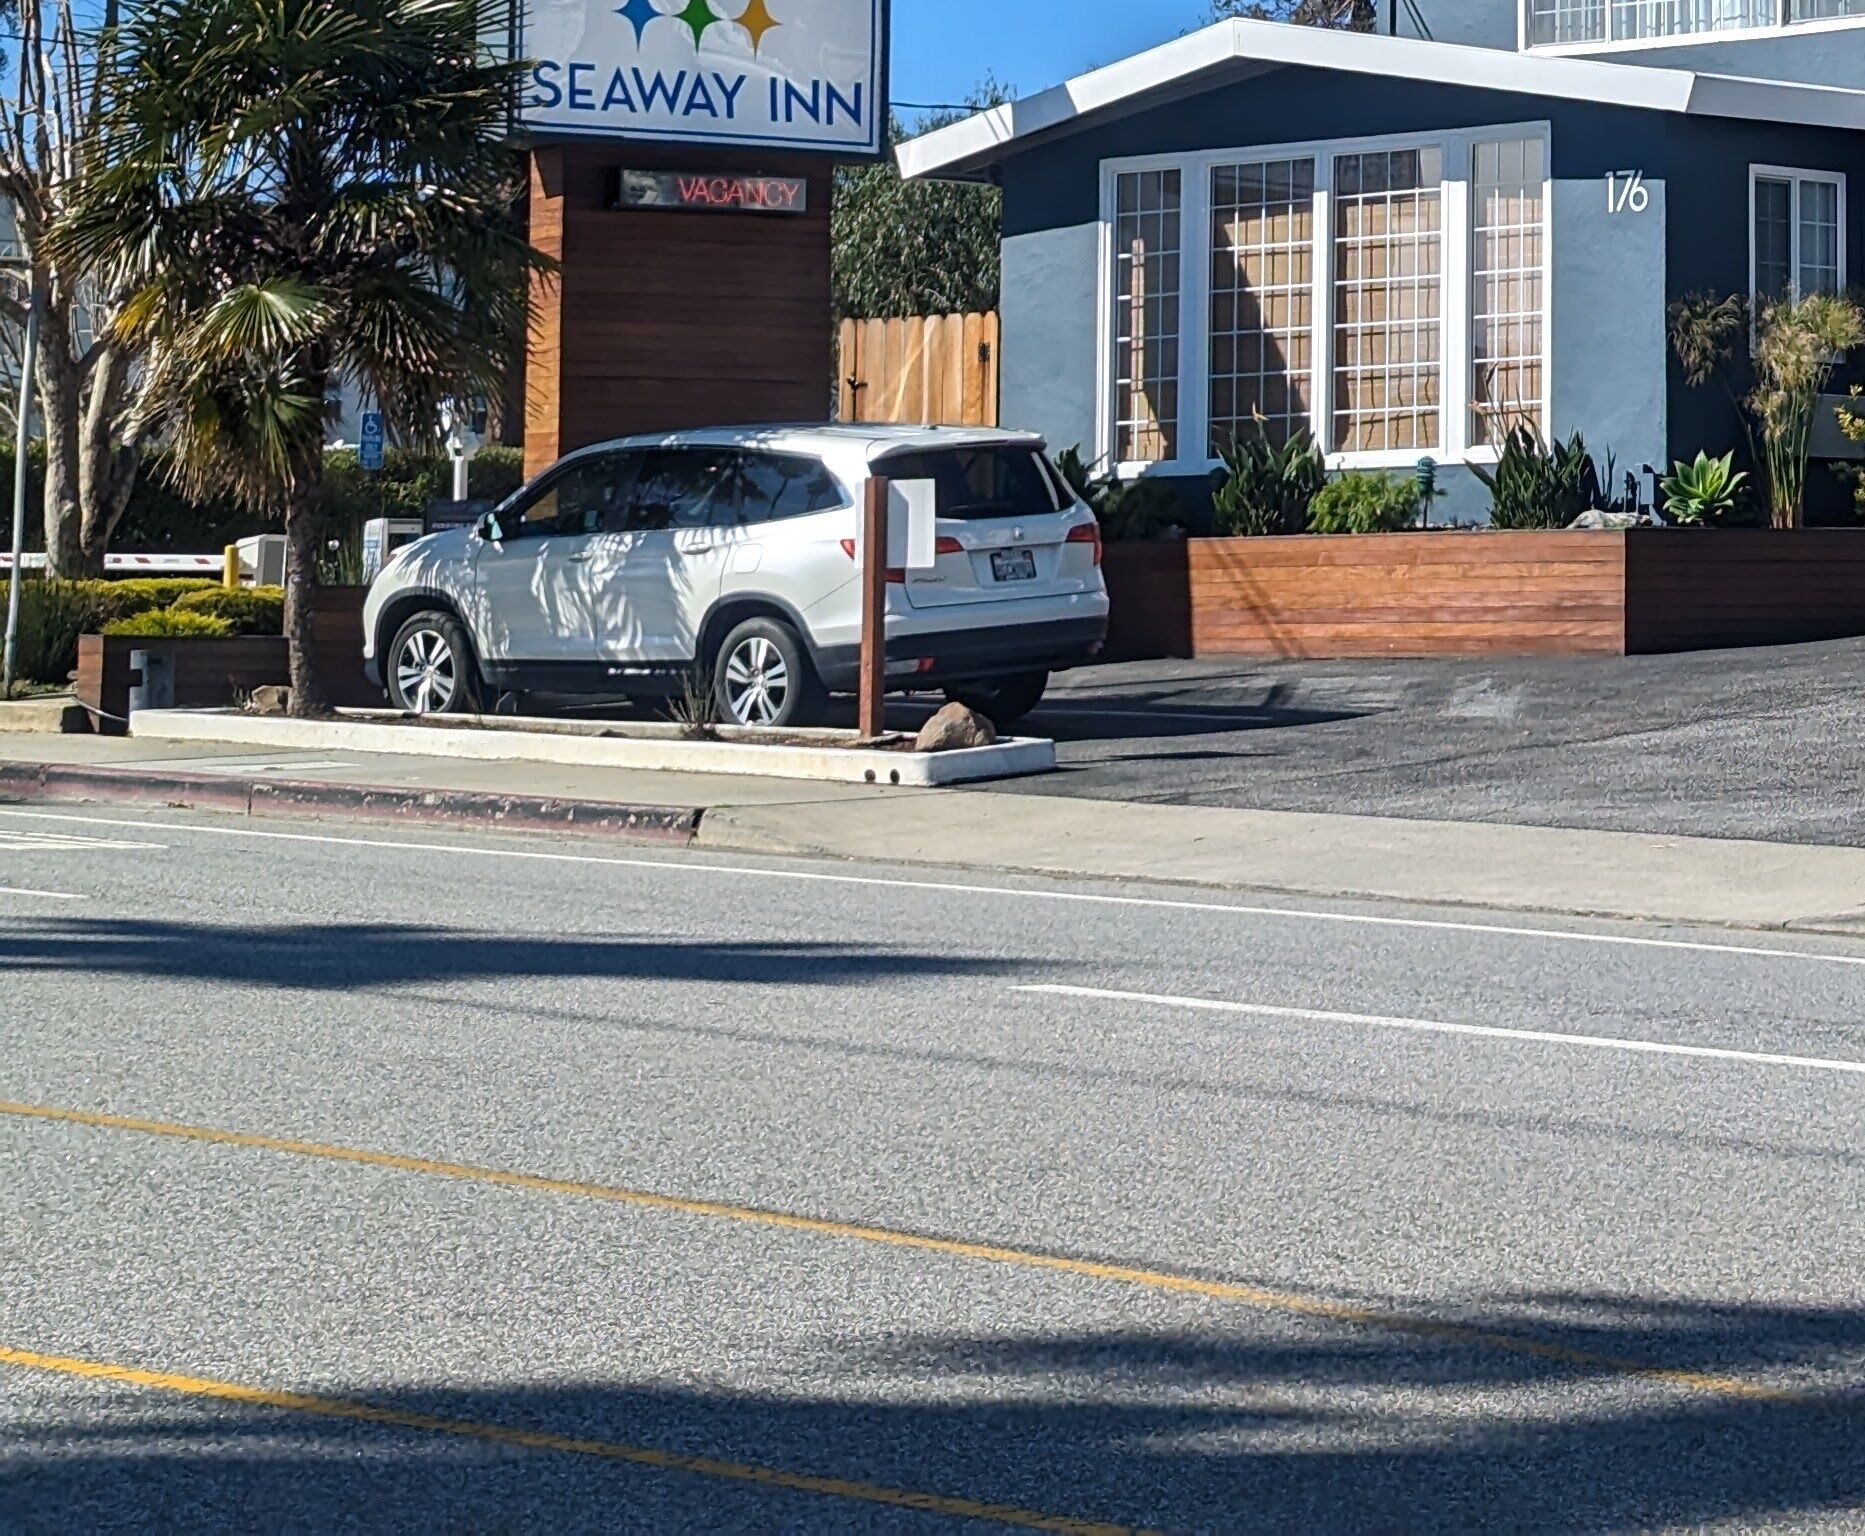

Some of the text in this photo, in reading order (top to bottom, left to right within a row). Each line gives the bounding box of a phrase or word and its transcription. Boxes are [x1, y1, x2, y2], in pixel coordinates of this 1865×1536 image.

[532, 60, 863, 127] SEAWAY INN
[678, 176, 799, 207] VACANCY
[1604, 169, 1649, 213] 176
